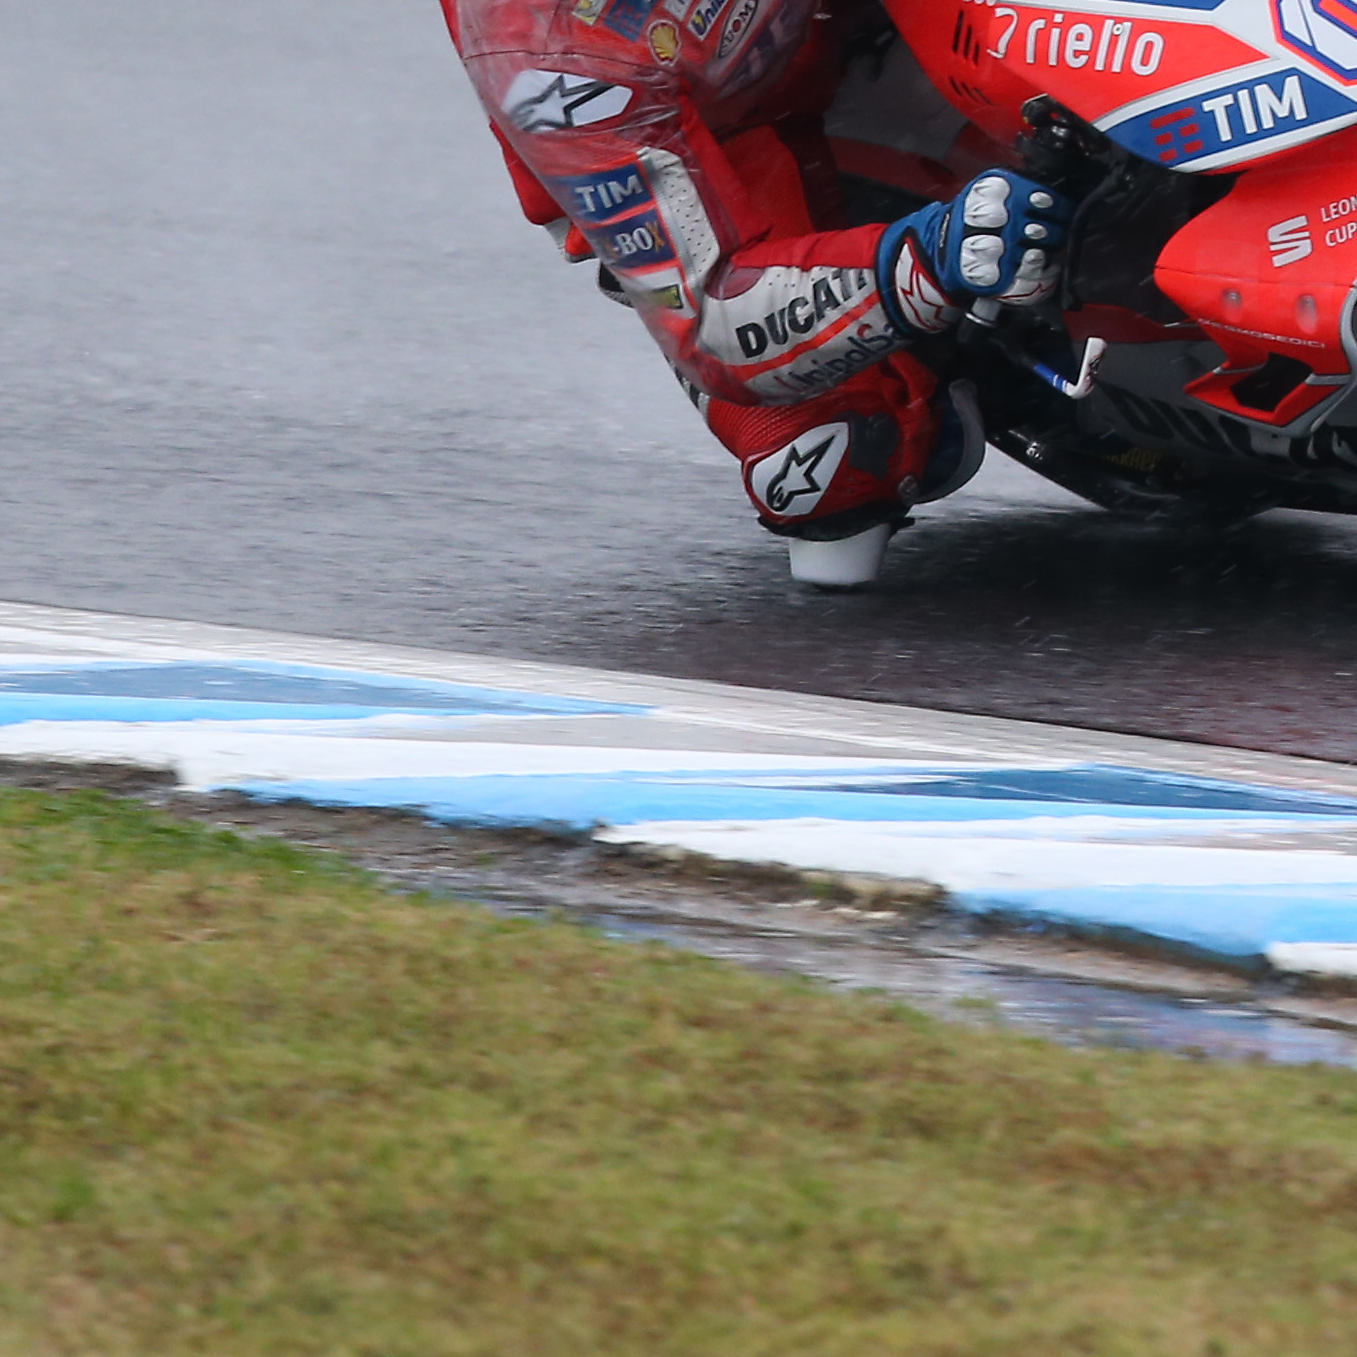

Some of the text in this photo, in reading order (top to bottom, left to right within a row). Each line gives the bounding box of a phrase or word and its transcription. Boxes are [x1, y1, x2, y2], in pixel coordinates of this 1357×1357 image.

[1025, 12, 1165, 77] riello
[1201, 75, 1309, 142] TIM
[574, 173, 645, 213] TIM
